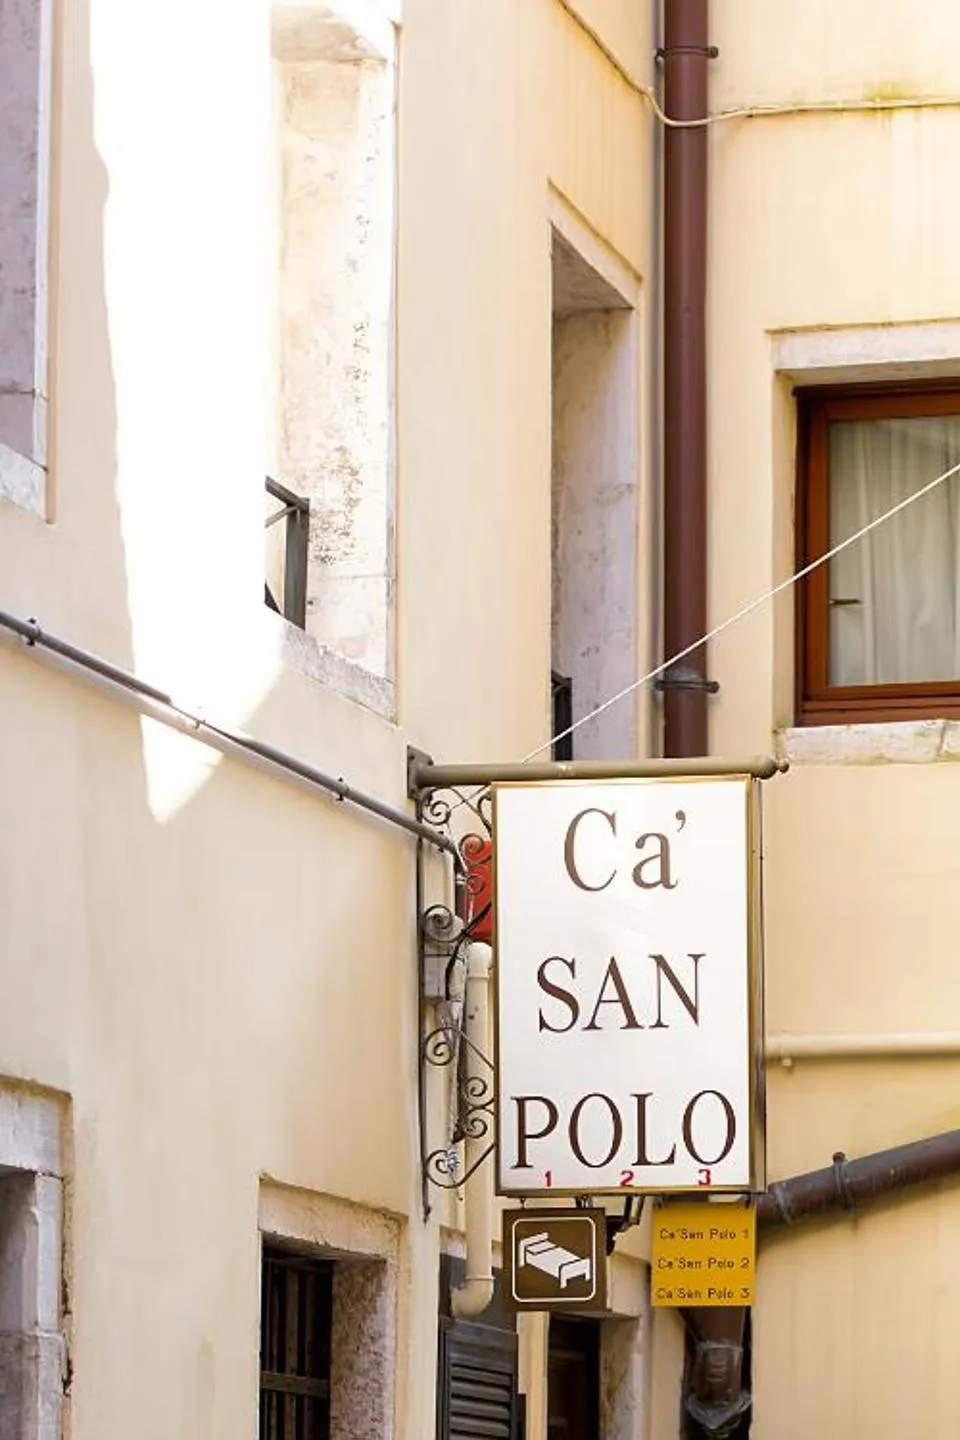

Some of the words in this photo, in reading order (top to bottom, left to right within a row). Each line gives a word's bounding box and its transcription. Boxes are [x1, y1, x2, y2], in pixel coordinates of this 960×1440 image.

[564, 808, 687, 892] Ca'
[537, 953, 706, 1034] SAN
[510, 1090, 736, 1169] POLO
[544, 1170, 552, 1188] 1
[619, 1170, 635, 1188] 2
[698, 1169, 711, 1187] 3
[709, 1228, 736, 1240] Polo
[741, 1228, 749, 1240] 1
[707, 1256, 734, 1269] Polo
[740, 1256, 750, 1269] 2
[707, 1287, 734, 1300] Polo
[740, 1287, 750, 1300] 3
